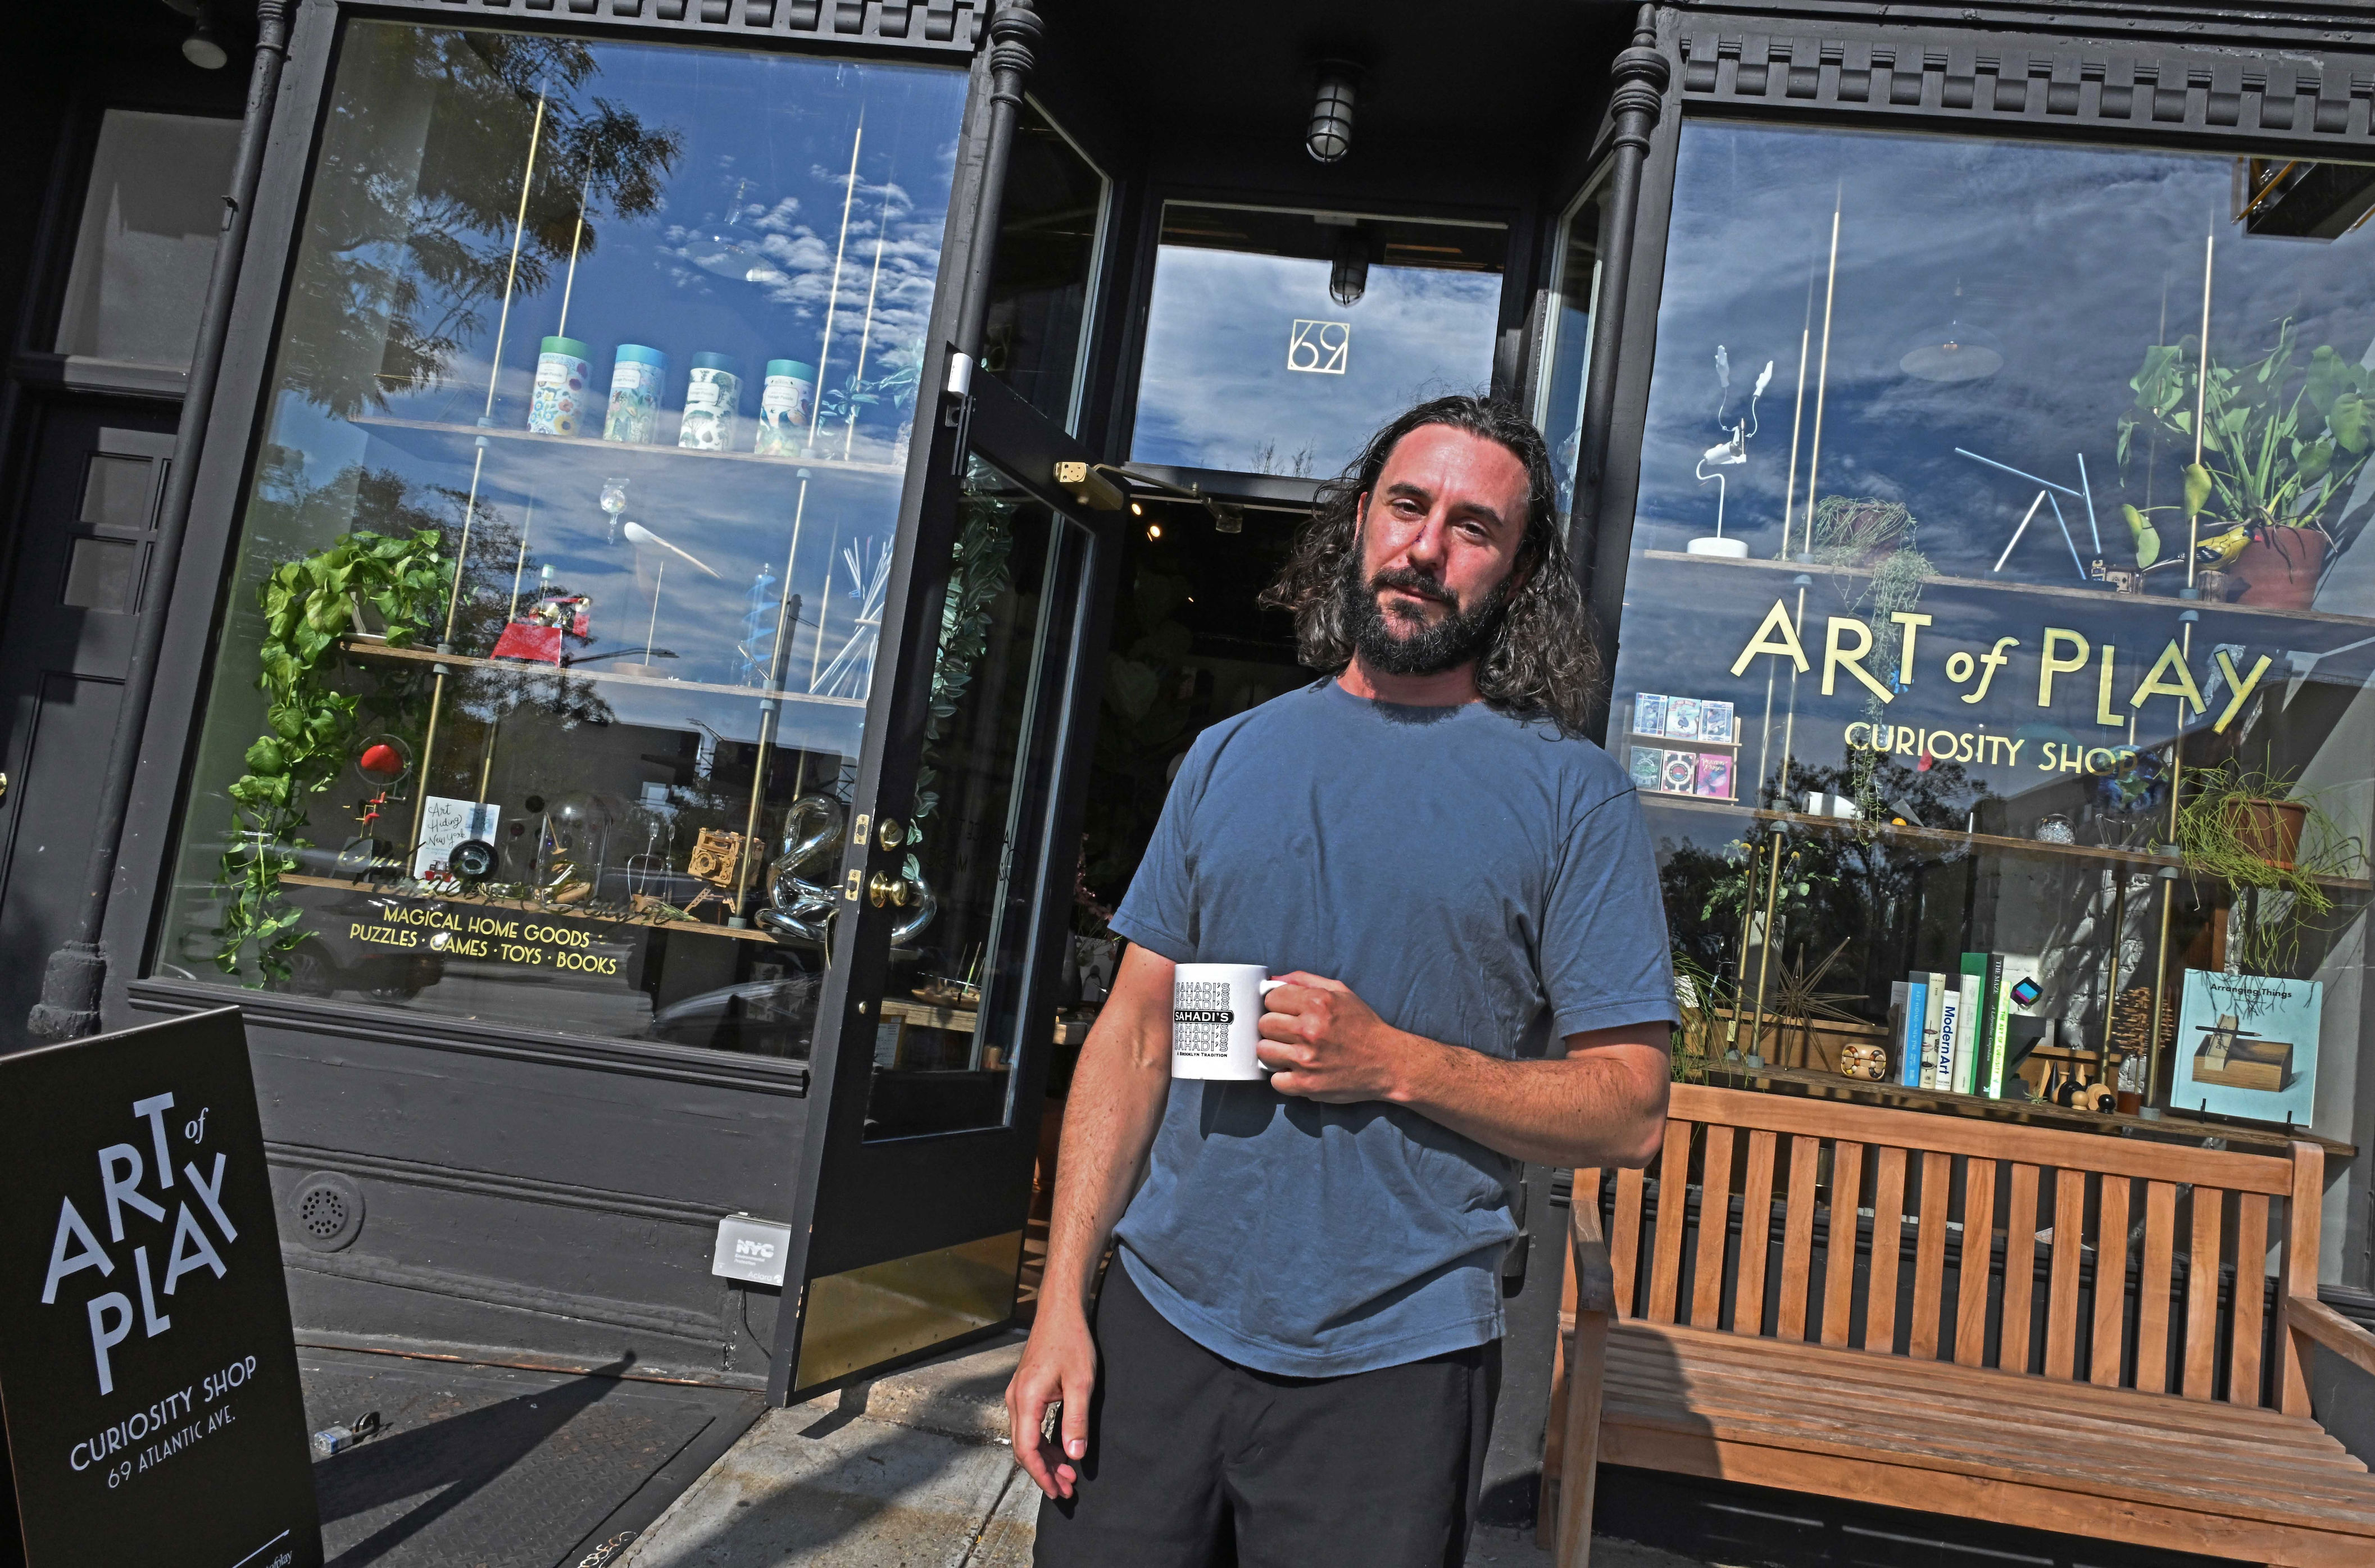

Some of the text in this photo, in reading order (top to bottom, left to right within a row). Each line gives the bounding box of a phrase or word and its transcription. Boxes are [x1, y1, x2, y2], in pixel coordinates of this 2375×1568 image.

[1289, 319, 1349, 373] 69
[1731, 598, 2273, 737] ART of PLAY
[1844, 721, 2138, 779] CURIOSITY SHOP
[428, 803, 451, 817] Art
[428, 814, 462, 833] Hiding
[426, 829, 466, 848] New York
[384, 905, 590, 948] MAGICAL HOME GOODS
[349, 923, 617, 975] PUZZLES GAMES TOYS BOOKS
[1176, 991, 1230, 1002] SAHADI'S
[1177, 982, 1230, 993] SAHADI'S
[2210, 983, 2292, 999] Arranging Things
[1175, 1012, 1229, 1022] SAHADI'S
[1175, 1032, 1228, 1043] SAHADI'S
[1175, 1041, 1228, 1052] SAHADI'S
[1939, 1006, 1955, 1075] Modern Art
[41, 1092, 208, 1305] ART of
[736, 1239, 774, 1258] NYC
[87, 1153, 238, 1396] PLAY
[748, 1271, 772, 1281] Aclara
[71, 1355, 257, 1472] CURIOSITY SHOP
[108, 1405, 237, 1489] 69 ATLANTIC AVE.
